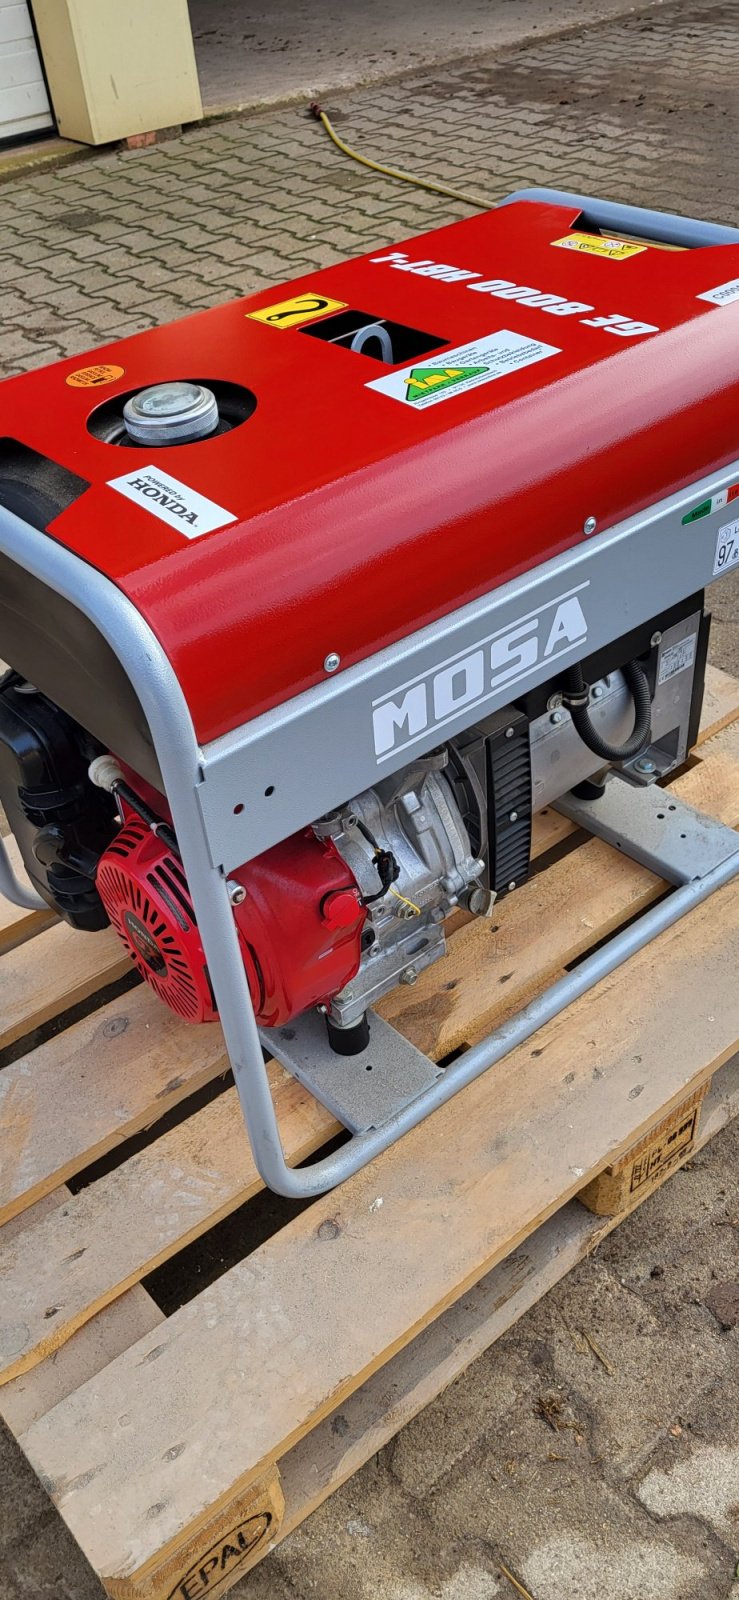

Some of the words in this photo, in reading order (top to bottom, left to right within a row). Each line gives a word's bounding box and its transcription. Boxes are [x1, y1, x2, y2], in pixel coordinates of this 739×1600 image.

[368, 252, 484, 283] HBT-L
[466, 279, 596, 316] 8000
[579, 313, 660, 337] GE
[127, 478, 199, 525] HONDA
[143, 475, 177, 496] POWERED
[717, 539, 735, 567] 97
[372, 596, 588, 756] MOSA
[179, 1531, 259, 1600] EPAL
